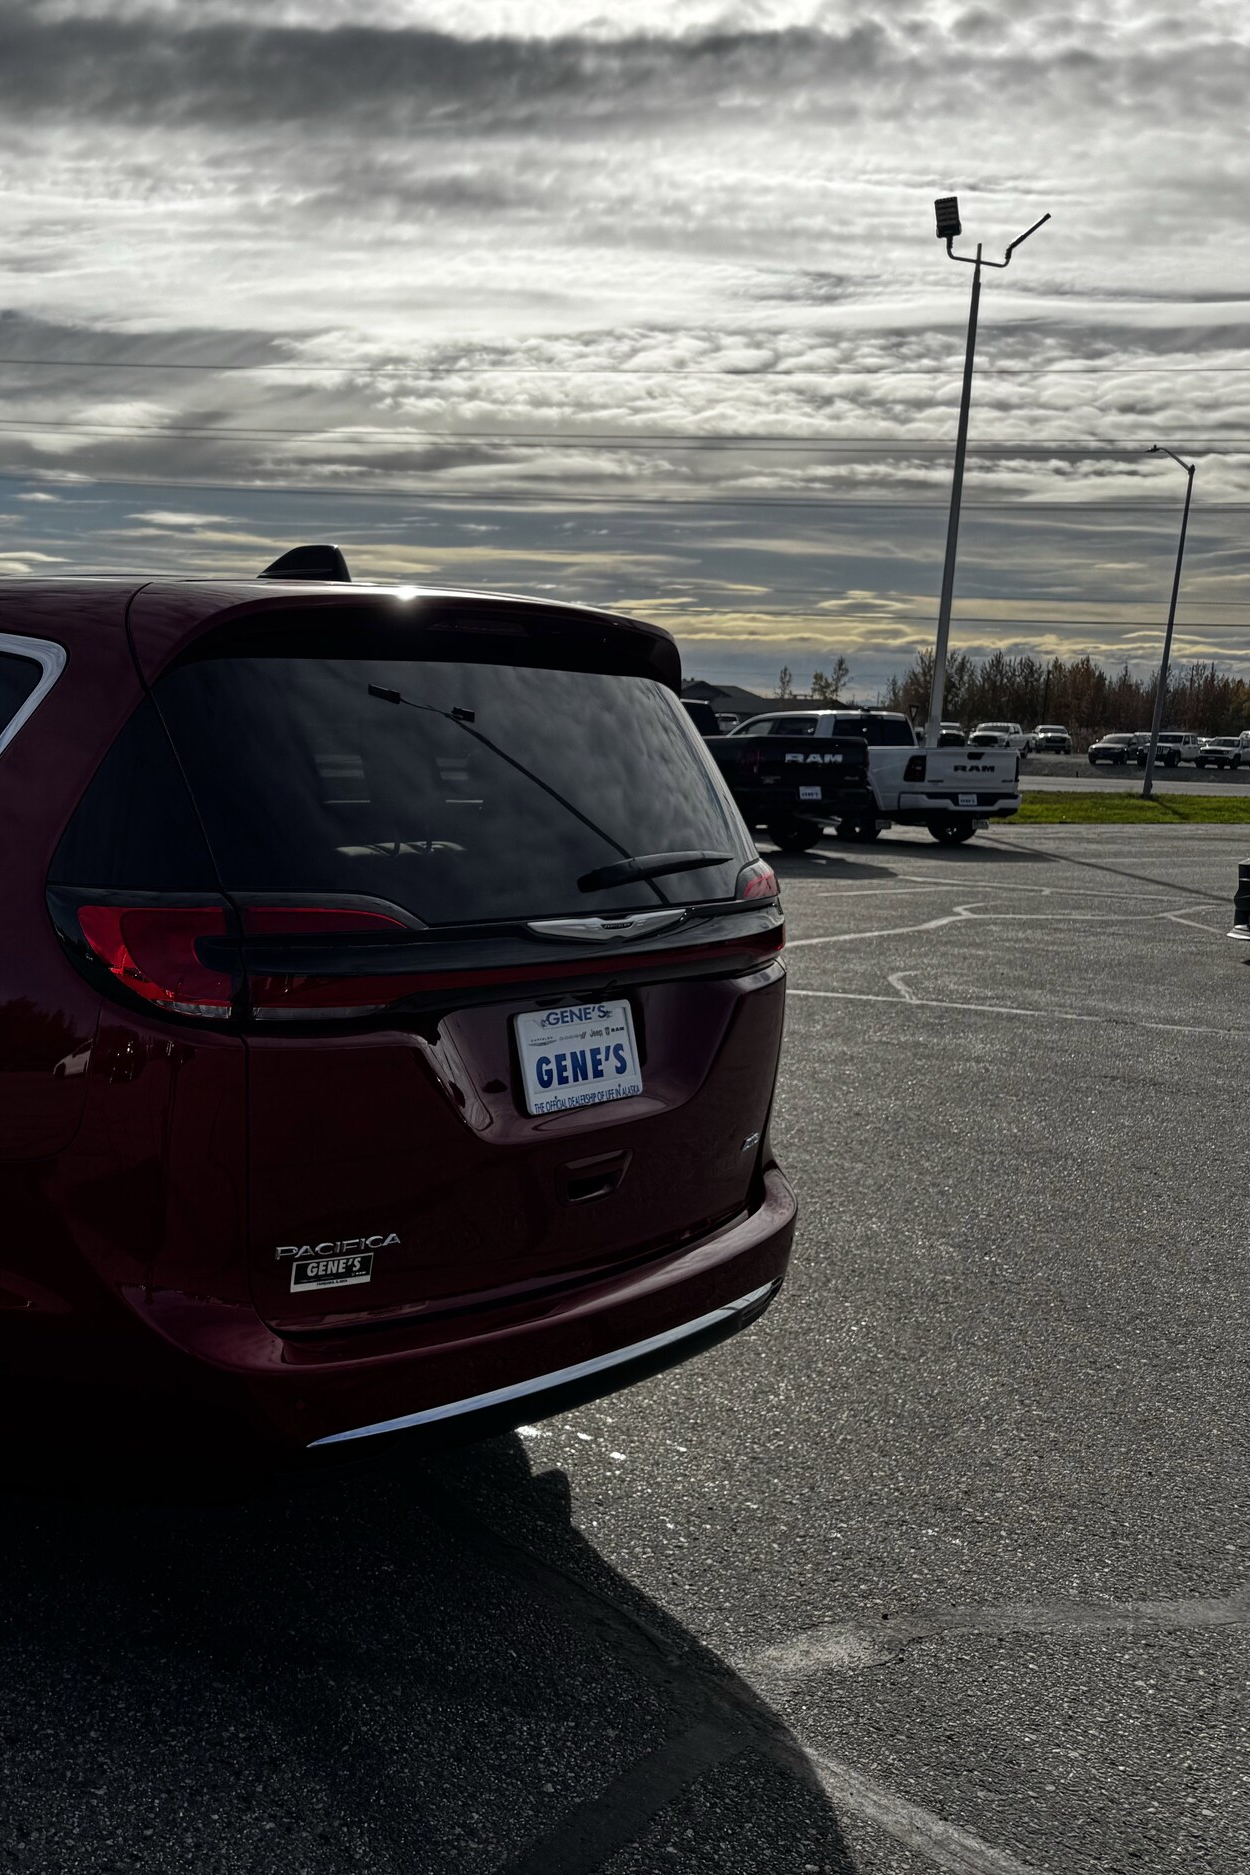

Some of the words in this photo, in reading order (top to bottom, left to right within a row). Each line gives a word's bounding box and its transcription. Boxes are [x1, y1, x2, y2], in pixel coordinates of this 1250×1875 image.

[784, 752, 844, 764] RAM
[953, 765, 996, 773] RAM
[546, 1005, 607, 1026] GENE'S
[589, 1028, 604, 1038] Jeep
[536, 1043, 627, 1089] GENE'S
[534, 1102, 545, 1113] THE
[545, 1098, 568, 1112] OFFICIAL
[567, 1091, 596, 1107] DEALERSHIP
[597, 1090, 605, 1101] OF
[604, 1089, 615, 1100] LIFE
[615, 1087, 622, 1098] IN
[621, 1084, 640, 1097] ALASKA
[275, 1233, 401, 1260] PACIFICA
[306, 1257, 362, 1277] GENE'S
